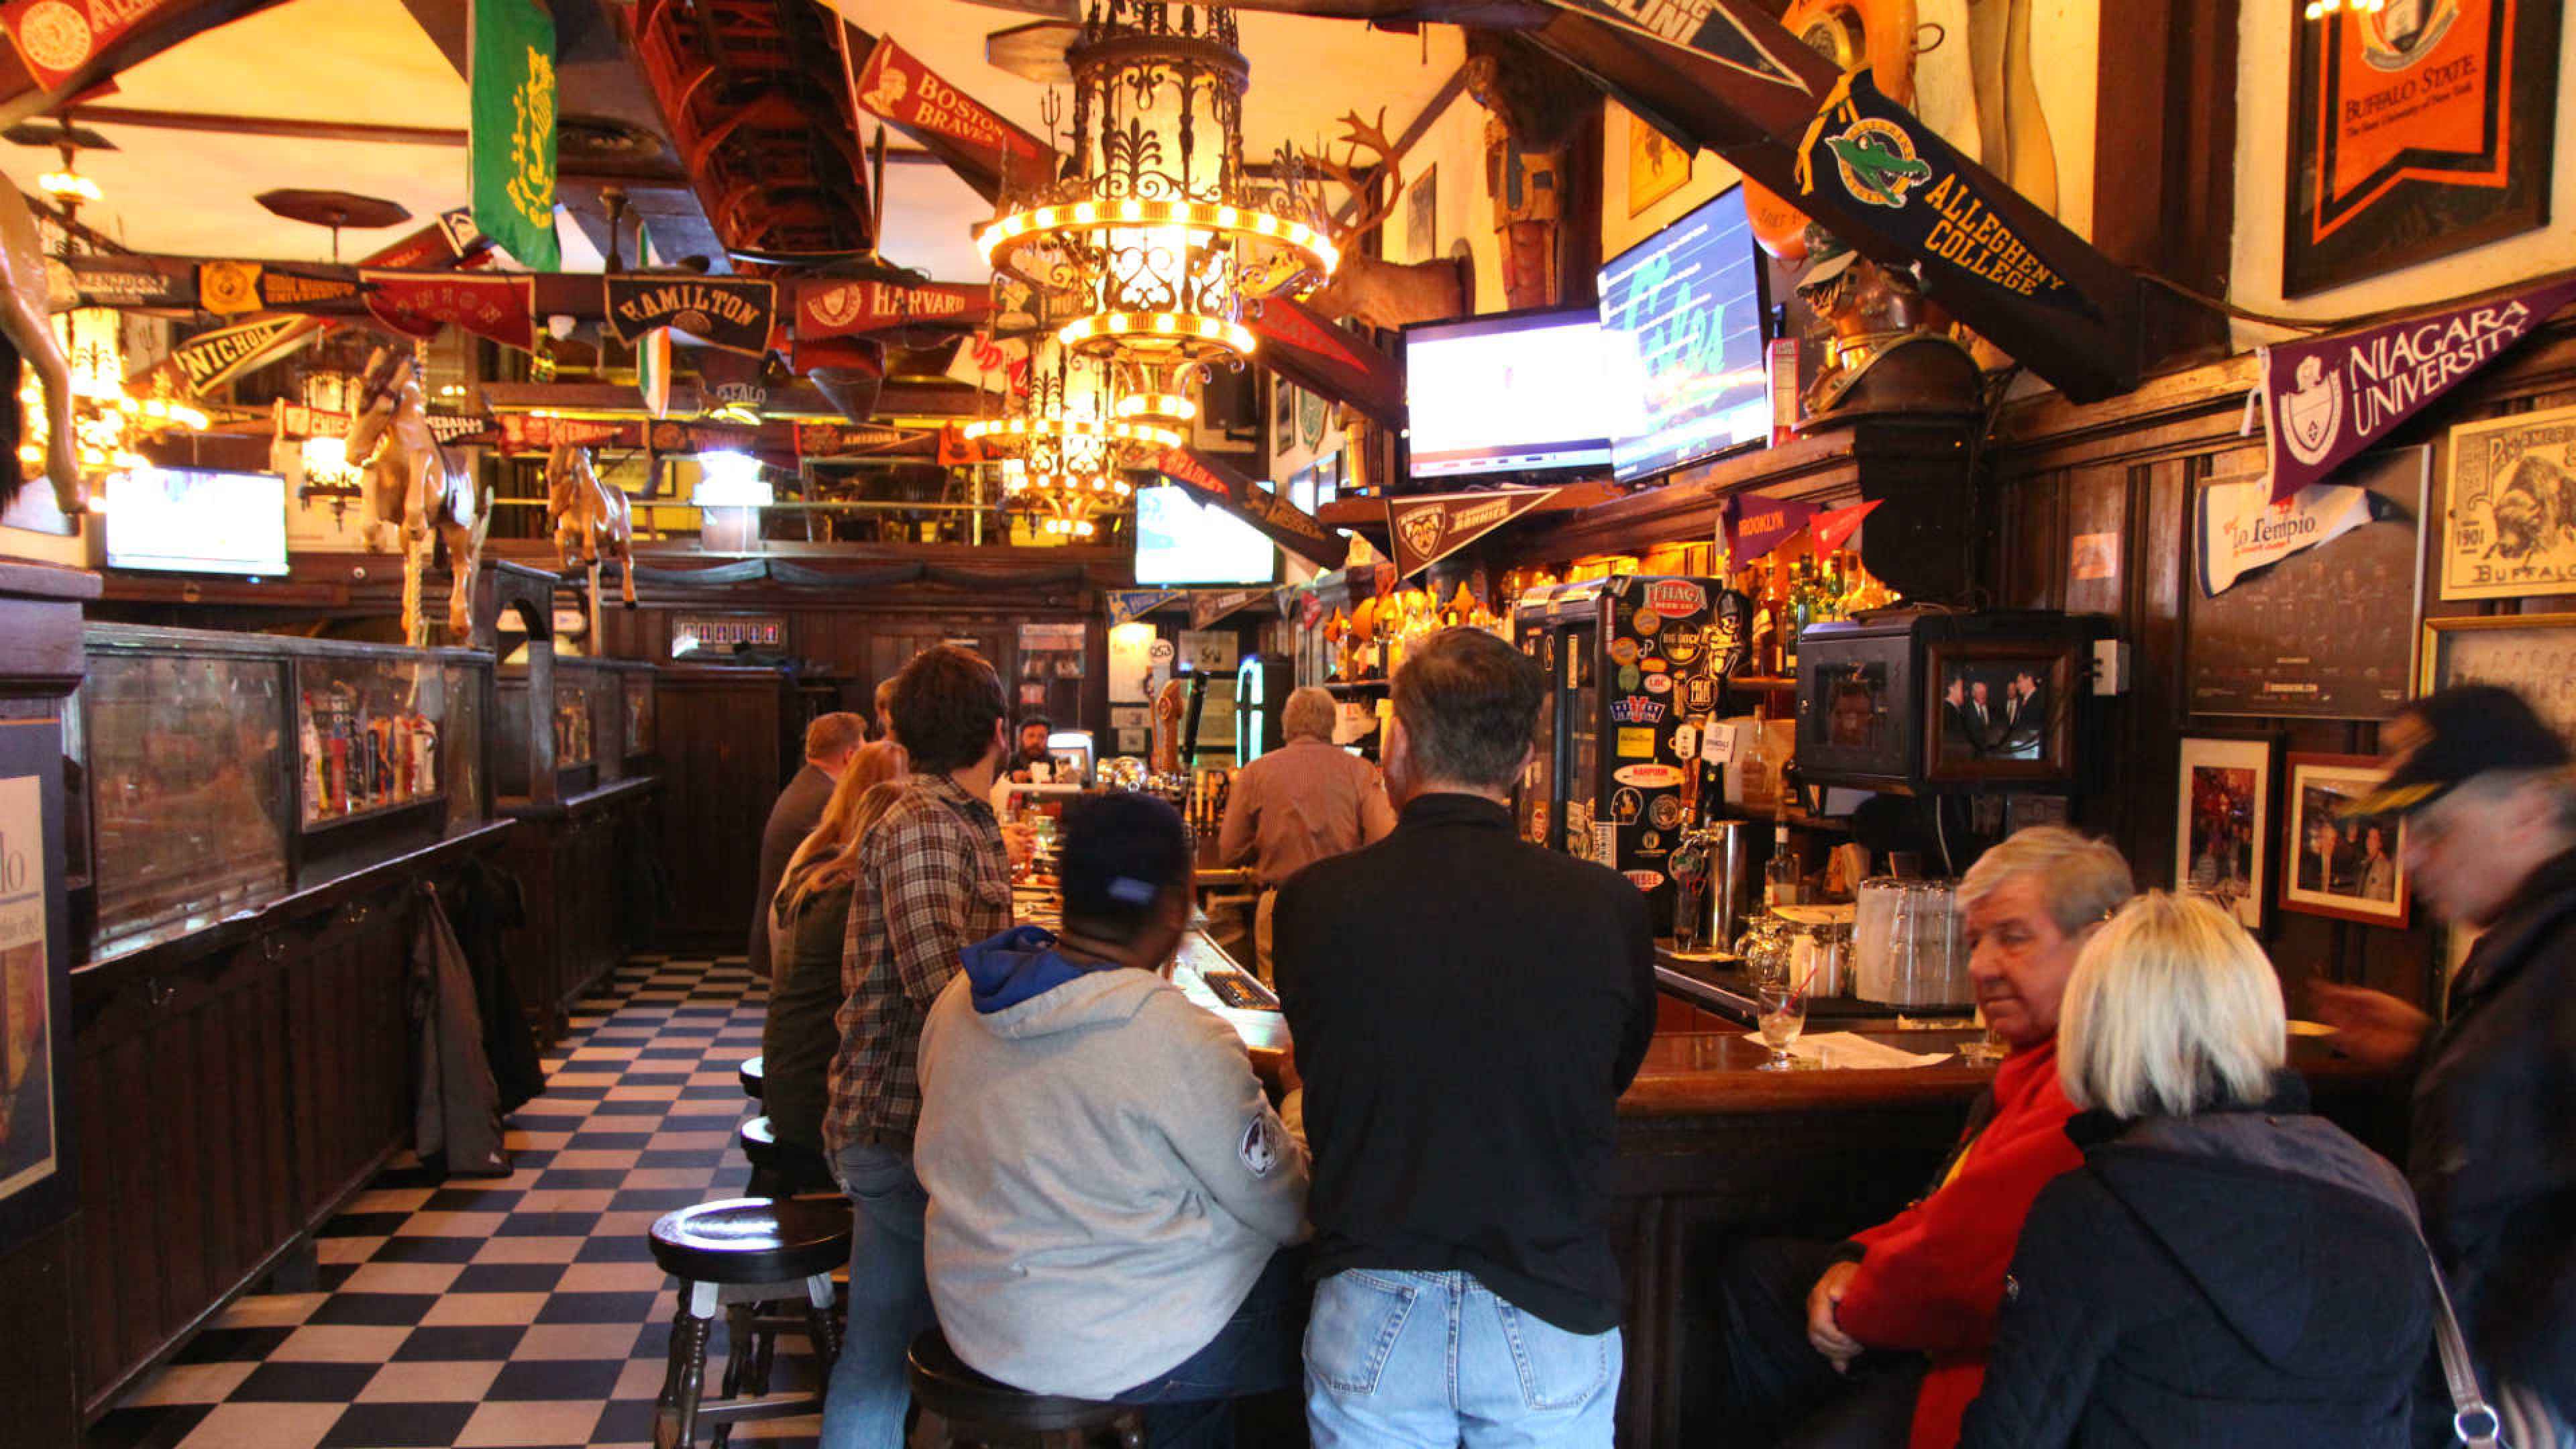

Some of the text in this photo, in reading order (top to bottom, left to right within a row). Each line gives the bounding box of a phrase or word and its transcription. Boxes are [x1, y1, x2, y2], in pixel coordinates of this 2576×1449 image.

[916, 72, 1004, 138] BOSTON
[2345, 78, 2417, 122] BUFFALO
[2421, 53, 2477, 94] STATE
[914, 101, 994, 143] BRAVES
[1924, 172, 2066, 290] ALLEGHENY
[1925, 219, 2038, 296] COLLEGE
[618, 284, 760, 326] HAMILTON
[873, 282, 966, 317] HARVARD
[2350, 300, 2530, 391] NIAGARA
[2354, 317, 2528, 437] UNIVERSITY
[1738, 511, 1785, 537] BROOKLYN
[1642, 583, 1707, 609] ITHACA
